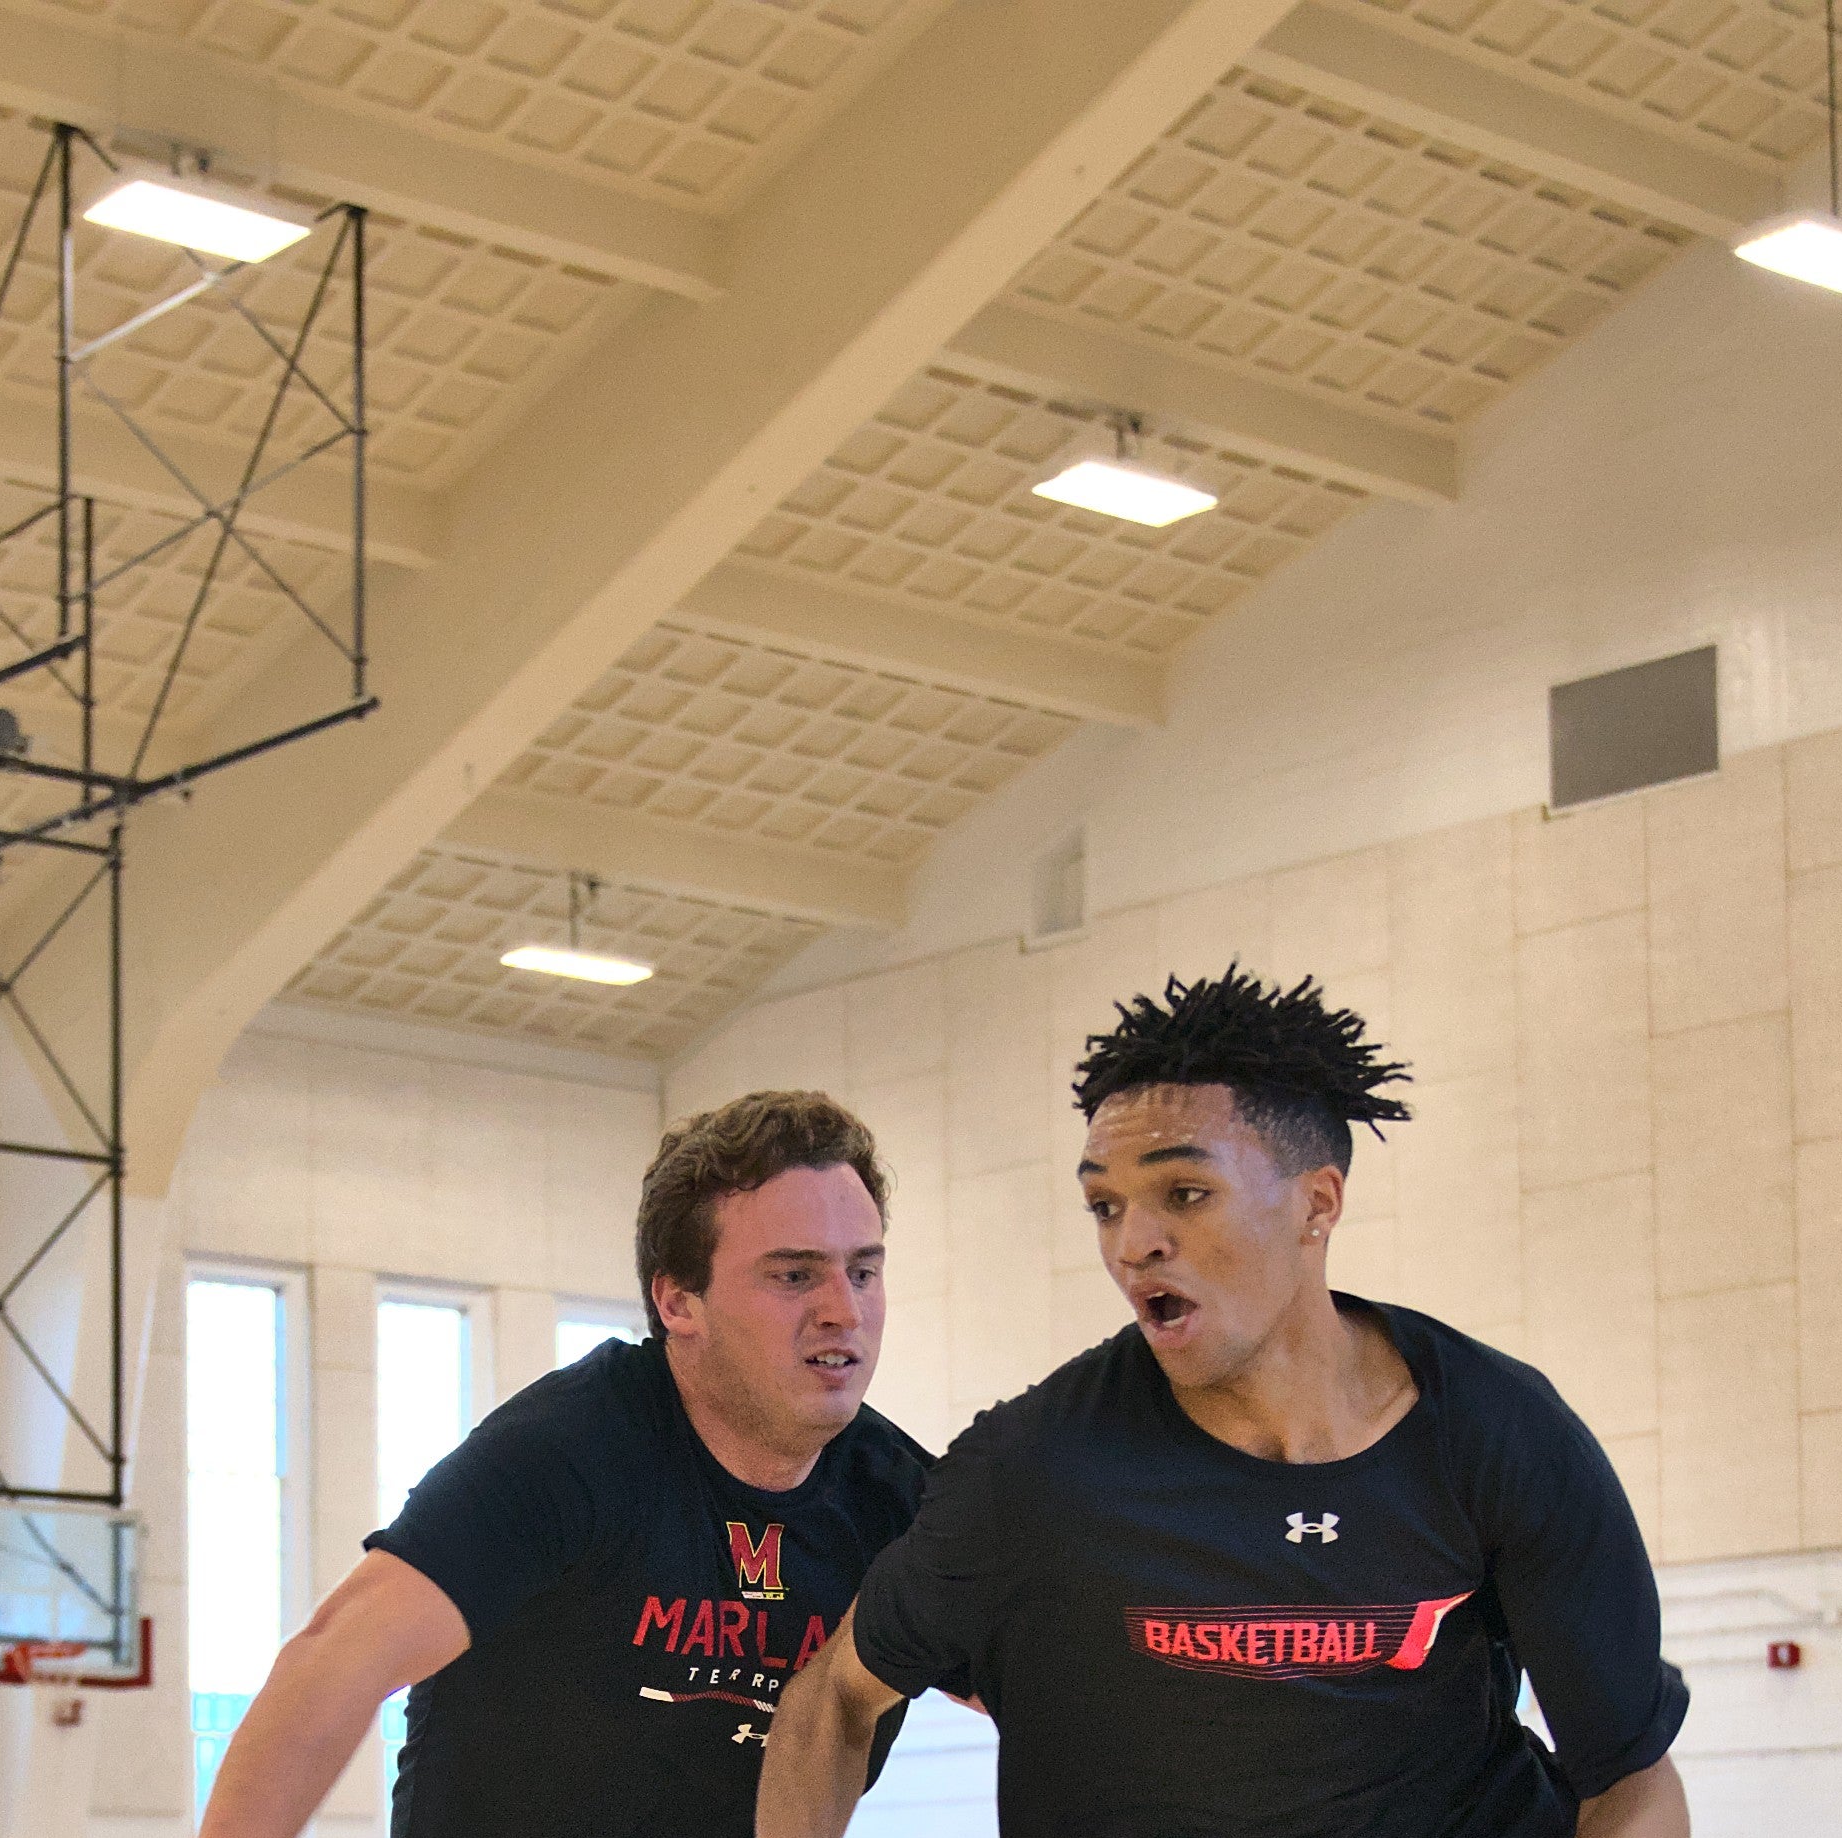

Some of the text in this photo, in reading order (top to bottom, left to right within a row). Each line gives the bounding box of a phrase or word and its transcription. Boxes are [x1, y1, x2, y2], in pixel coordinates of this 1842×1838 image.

[725, 1521, 785, 1590] M
[632, 1595, 845, 1672] MARLA
[1144, 1620, 1381, 1666] BASKETBALL
[688, 1667, 779, 1693] TERRP
